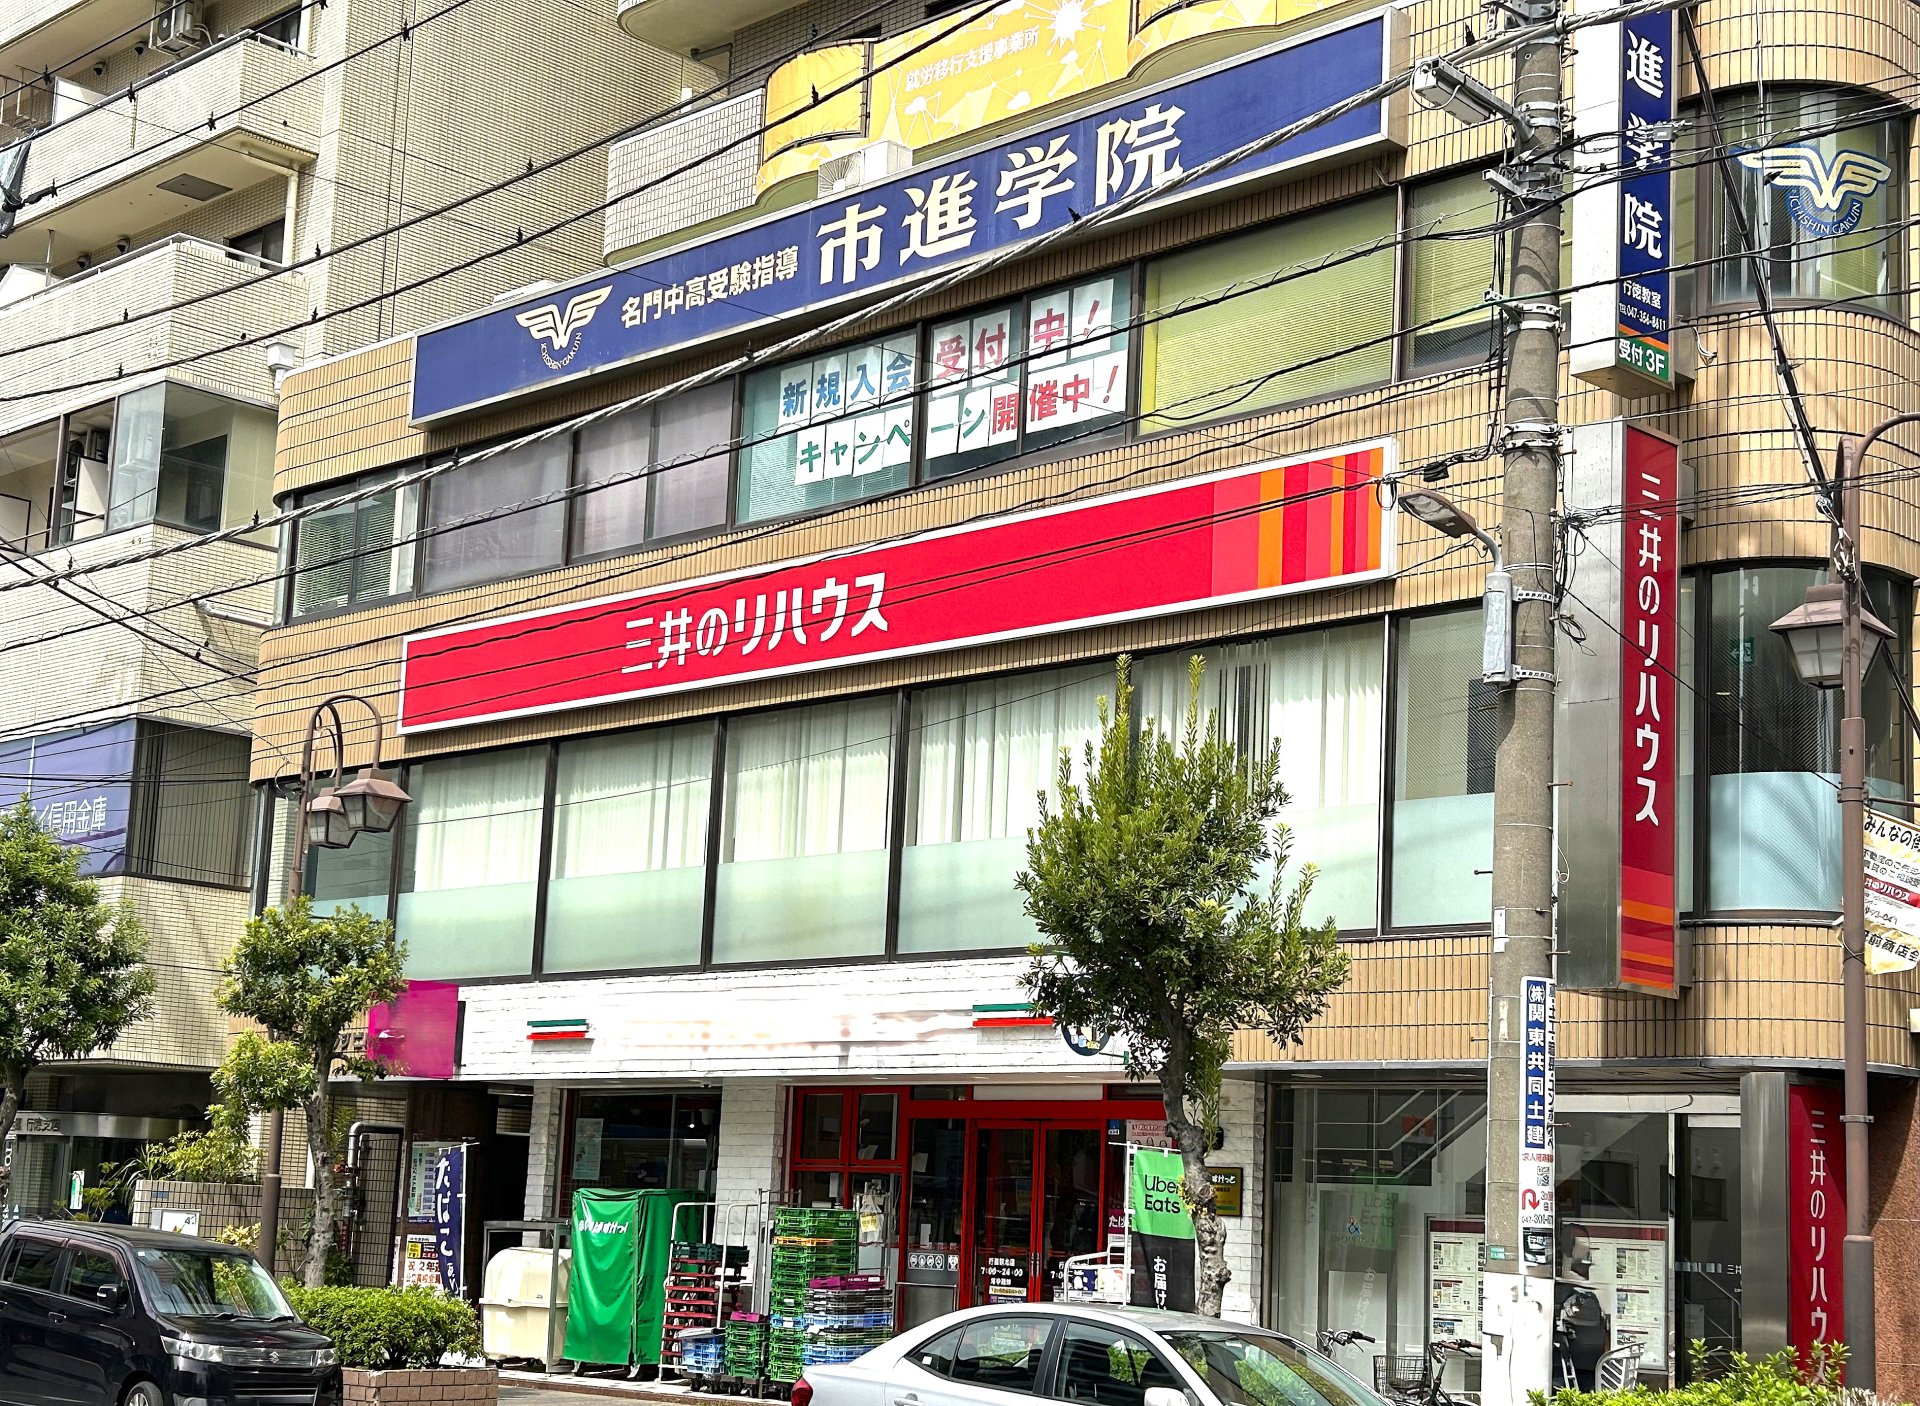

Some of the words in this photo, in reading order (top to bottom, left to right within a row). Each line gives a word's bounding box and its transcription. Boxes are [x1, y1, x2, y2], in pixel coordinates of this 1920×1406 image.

[906, 25, 1040, 91] 就労移行支援事業所
[817, 102, 1188, 286] 市進学院
[1832, 201, 1862, 235] GAKUIN
[621, 245, 799, 329] 名門中高受験指導
[1618, 338, 1643, 367] 受付
[1645, 349, 1665, 375] 3F
[621, 572, 889, 674] 三井のリハウス
[1634, 472, 1663, 827] 三井のリハウス
[1144, 1174, 1180, 1194] Uber
[1144, 1193, 1181, 1214] Eats
